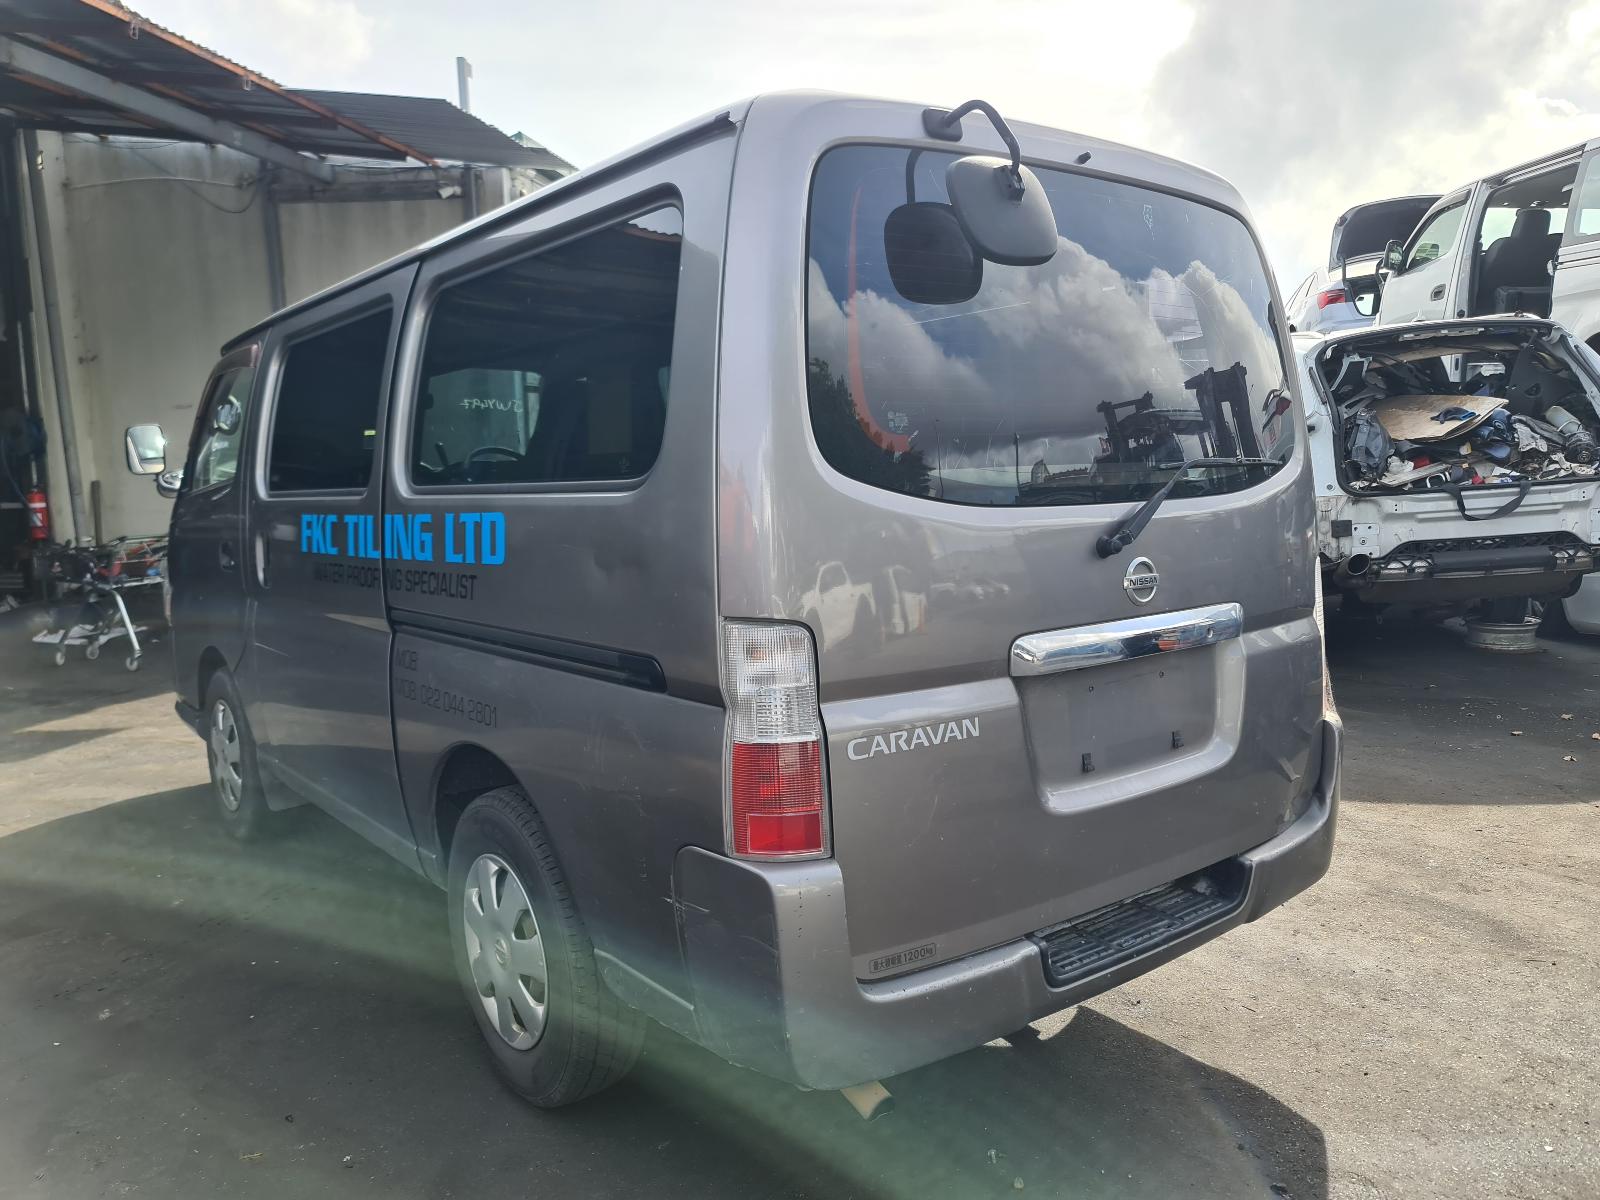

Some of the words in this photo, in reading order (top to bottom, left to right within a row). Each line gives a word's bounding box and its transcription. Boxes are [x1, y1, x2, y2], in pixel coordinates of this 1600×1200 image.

[301, 514, 338, 555] FKC
[344, 514, 433, 561] TILING
[445, 511, 506, 565] LTD
[405, 569, 477, 601] SPECIALIST
[1130, 577, 1157, 587] NISSAN
[421, 684, 441, 710] 022
[443, 692, 465, 715] 044
[468, 699, 497, 729] 2801
[847, 716, 980, 761] CARAVAN
